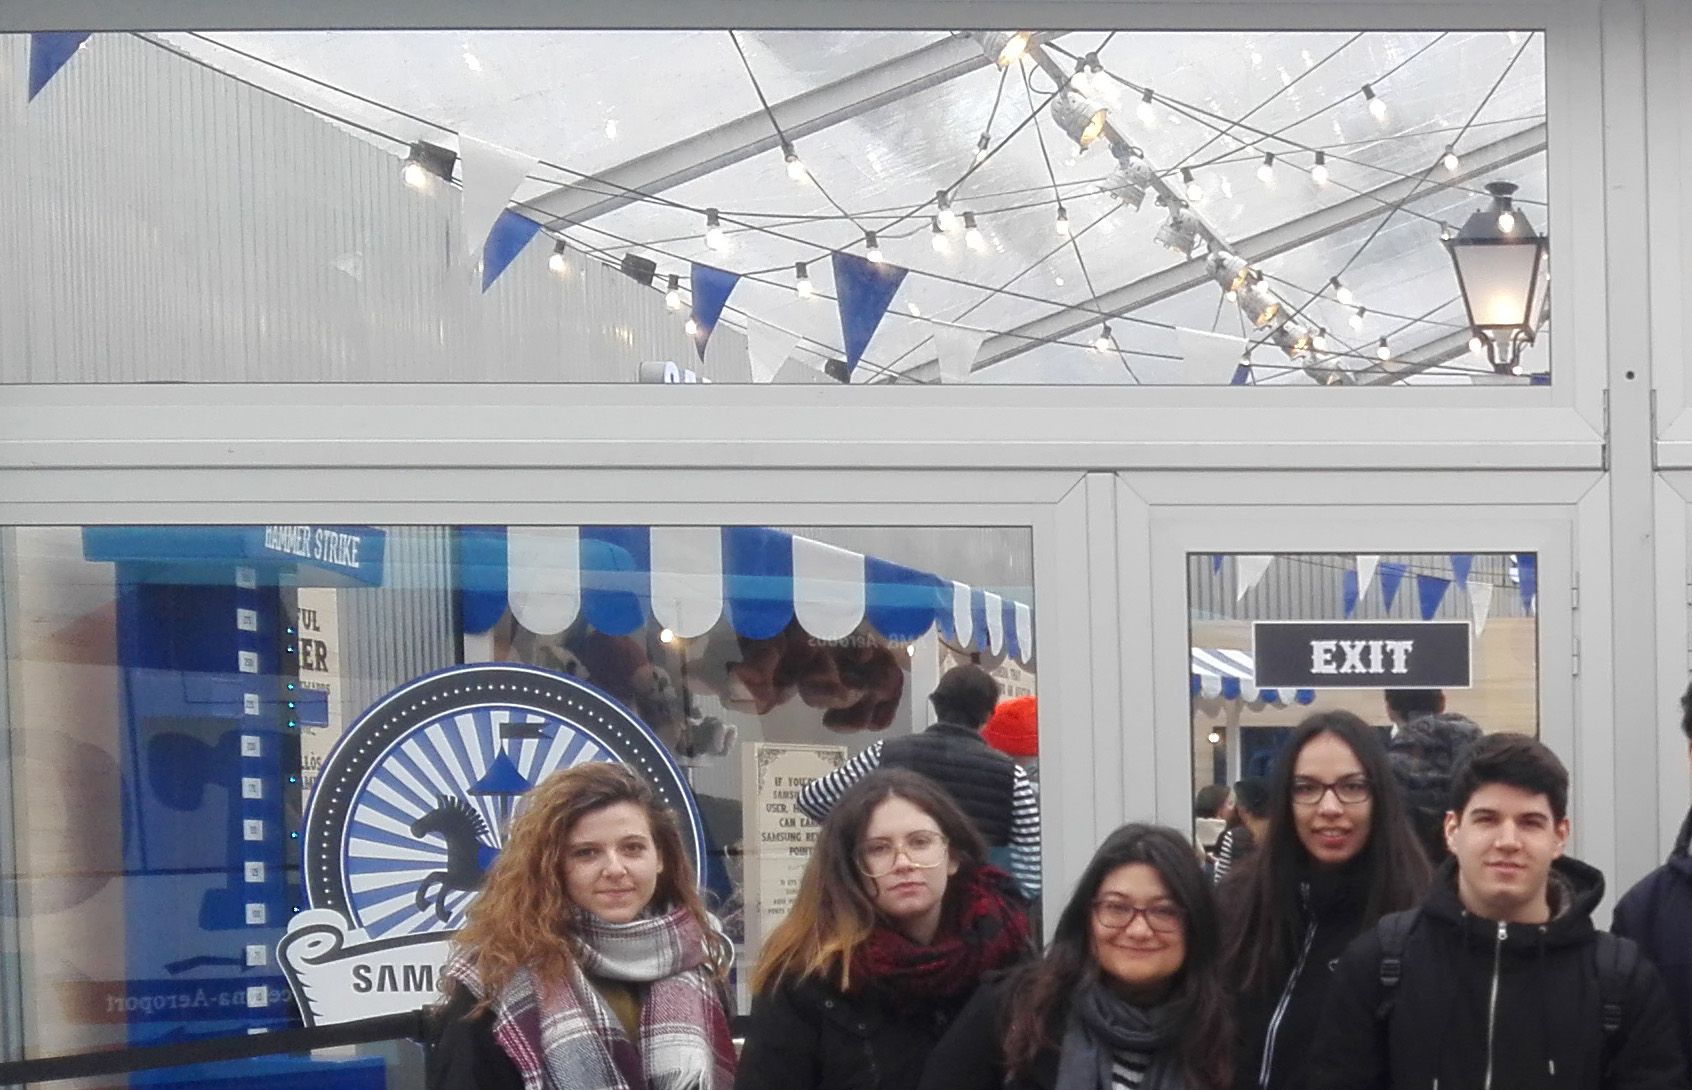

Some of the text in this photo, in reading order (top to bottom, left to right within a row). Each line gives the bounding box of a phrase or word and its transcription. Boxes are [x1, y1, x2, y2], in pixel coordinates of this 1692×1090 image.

[265, 526, 360, 568] HAMMER STRIKE
[301, 609, 320, 632] UL
[300, 638, 328, 672] ER
[1310, 640, 1414, 675] EXIT
[779, 818, 796, 827] CAN
[762, 832, 801, 841] SAMSUNG
[789, 847, 813, 855] POINT
